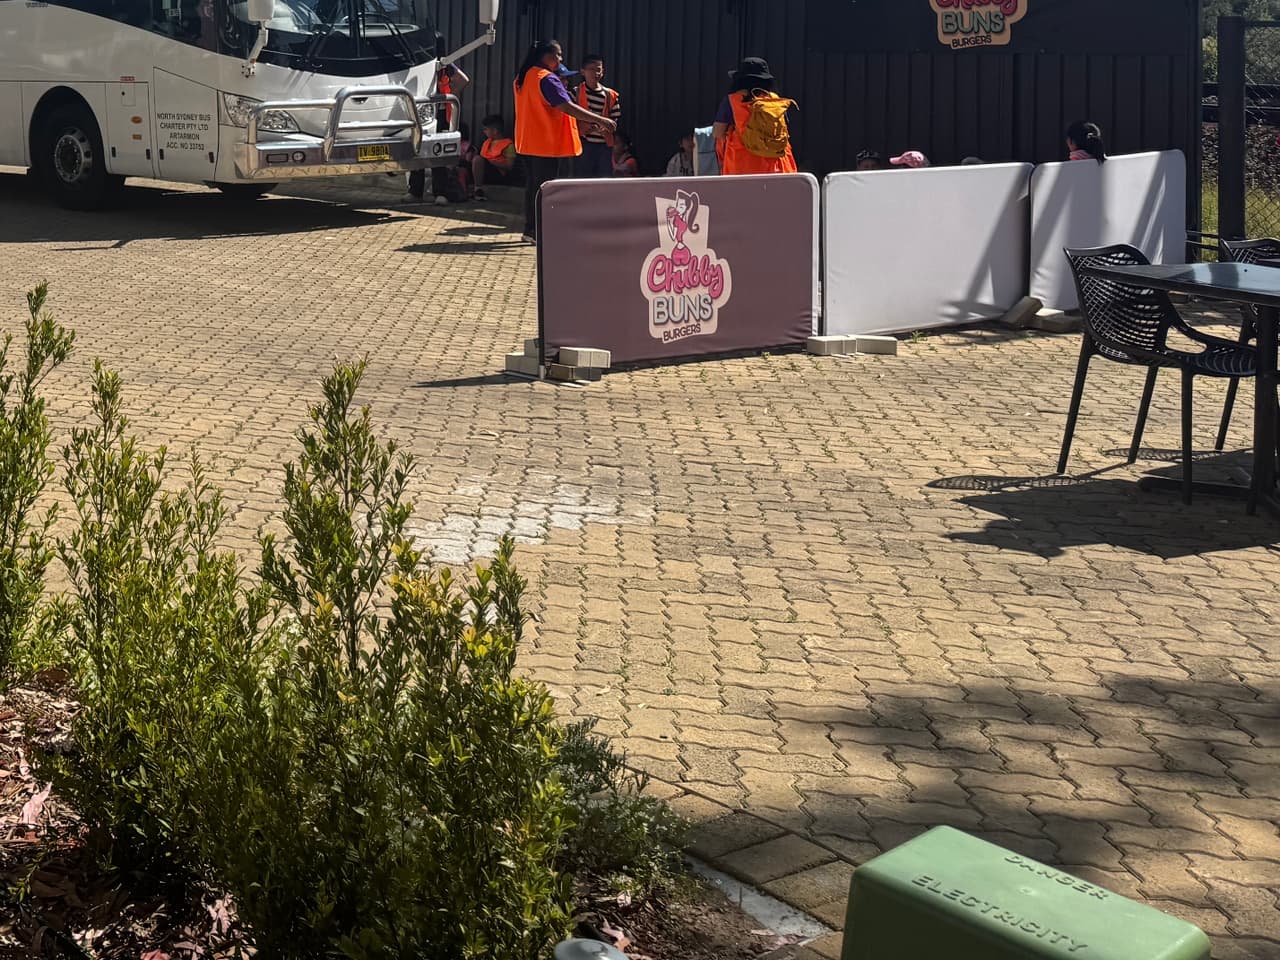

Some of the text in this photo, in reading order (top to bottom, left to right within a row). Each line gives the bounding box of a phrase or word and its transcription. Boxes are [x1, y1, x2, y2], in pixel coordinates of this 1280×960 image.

[942, 11, 1005, 34] BUNS
[952, 35, 992, 48] BURGERS
[156, 112, 211, 121] NORTH SYDNEY BUS
[159, 122, 185, 130] CHARTER
[198, 123, 209, 131] LTD
[169, 132, 200, 140] ARTARMON
[647, 254, 724, 299] Chubby
[654, 294, 713, 325] BUNS
[663, 323, 701, 341] BURGERS
[1004, 855, 1109, 900] DANGER
[911, 875, 1088, 952] ELECTRICITY
